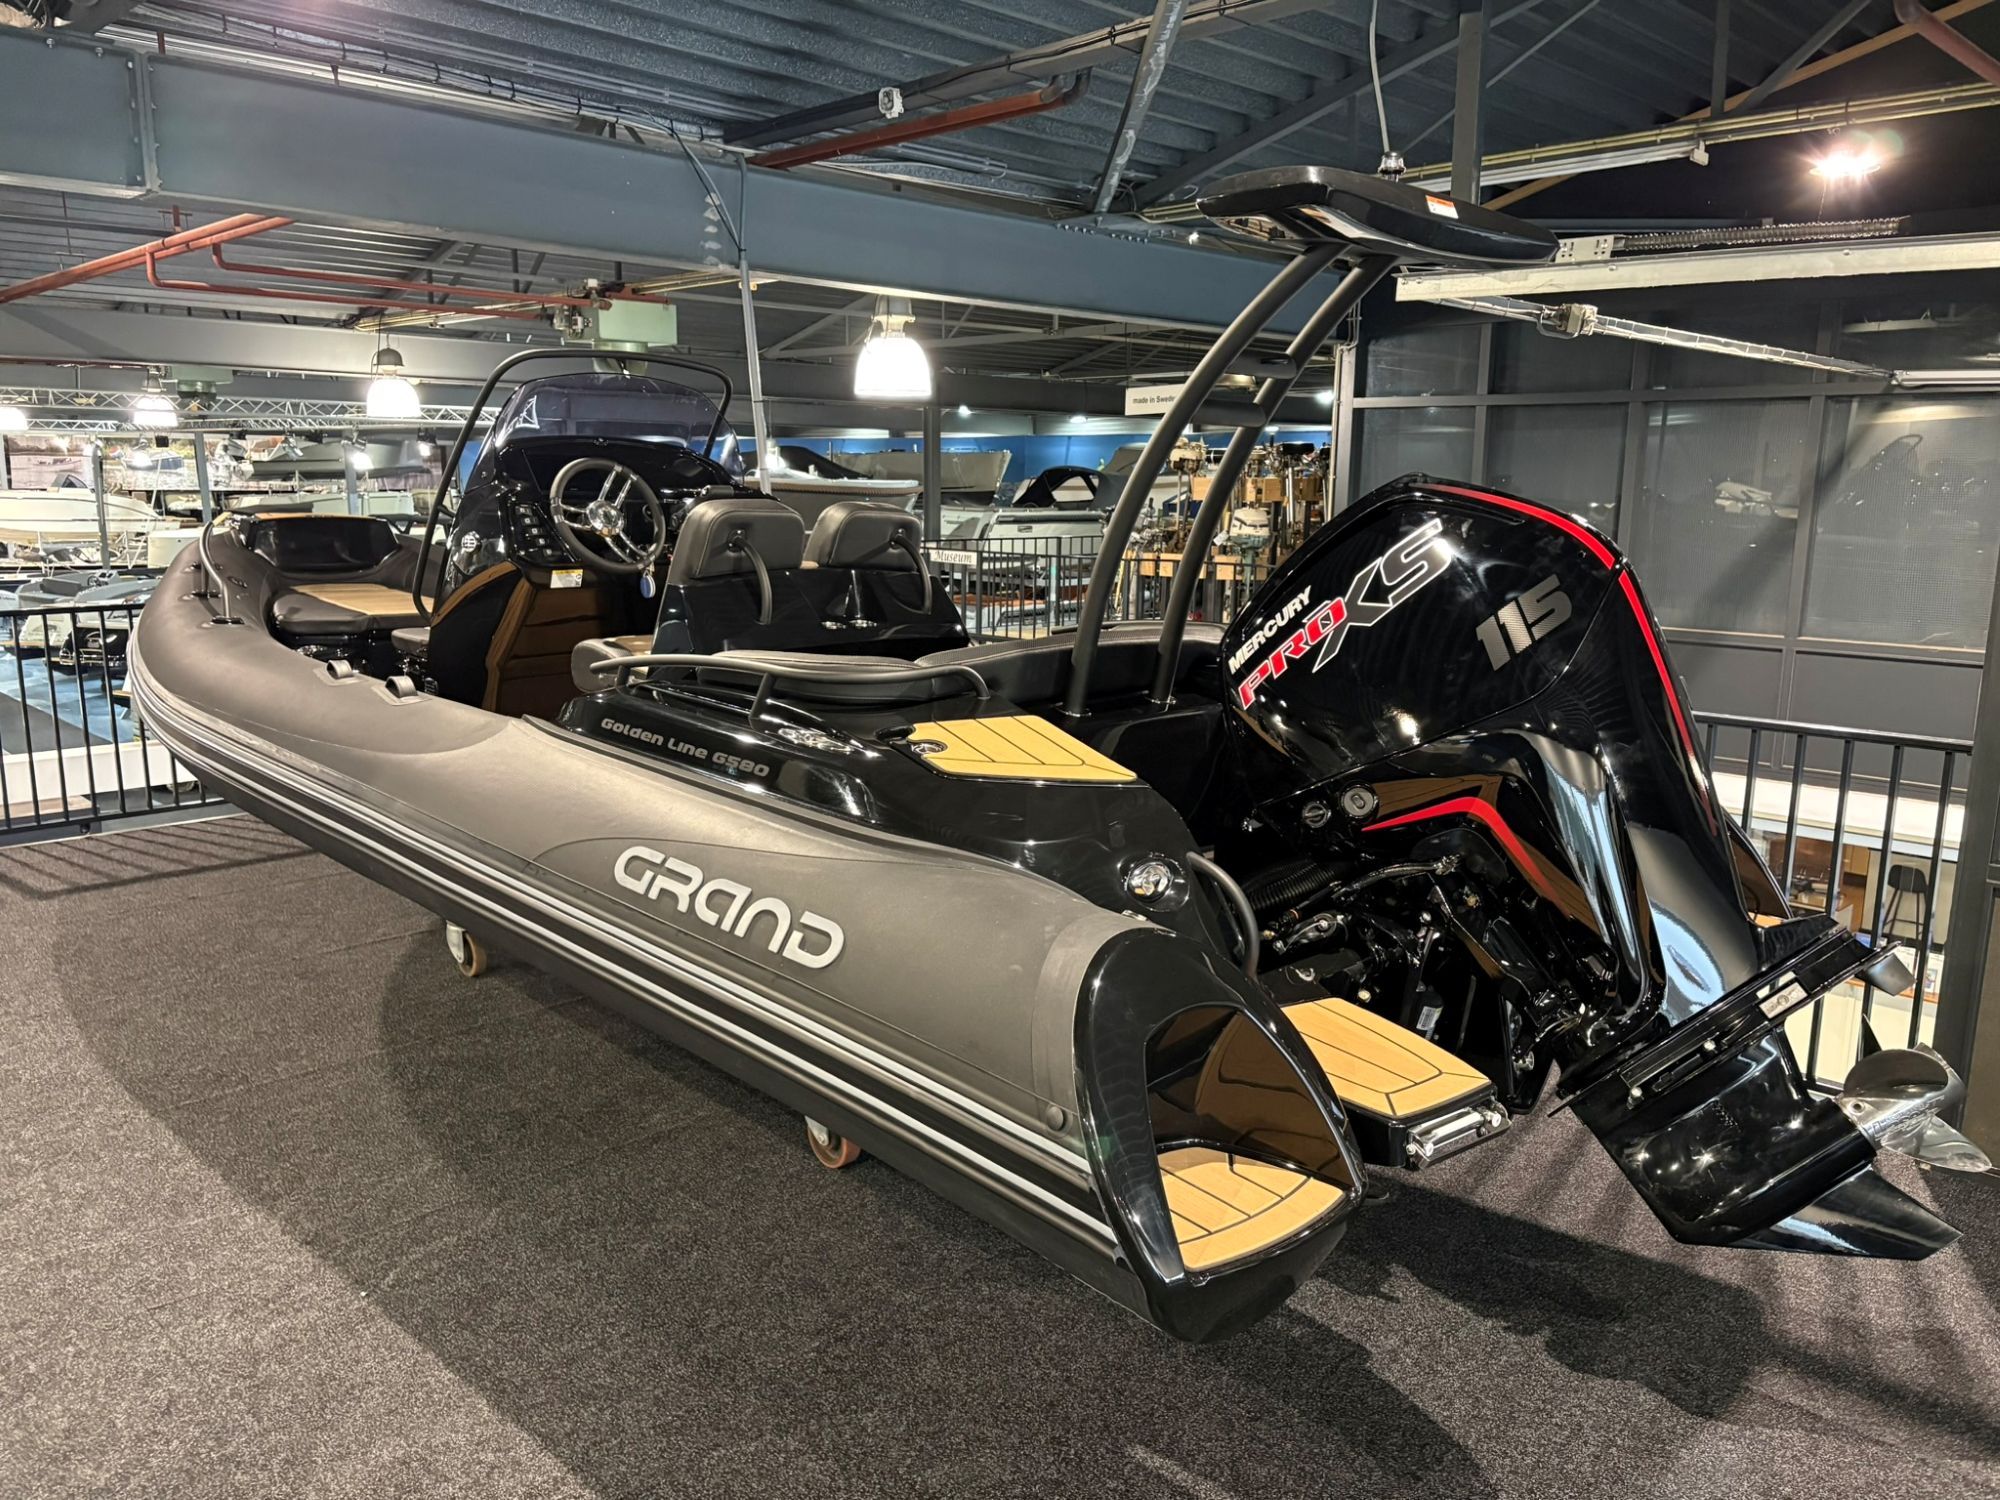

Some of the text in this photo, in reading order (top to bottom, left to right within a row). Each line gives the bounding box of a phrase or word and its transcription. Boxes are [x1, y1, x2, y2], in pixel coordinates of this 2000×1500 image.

[1132, 396, 1148, 404] made
[1156, 395, 1176, 403] Swede
[934, 551, 972, 563] Museum
[1228, 585, 1311, 674] MERCURY
[1476, 574, 1573, 671] 115
[601, 718, 664, 746] Golden
[712, 751, 770, 777] G580
[614, 846, 845, 969] GRAND
